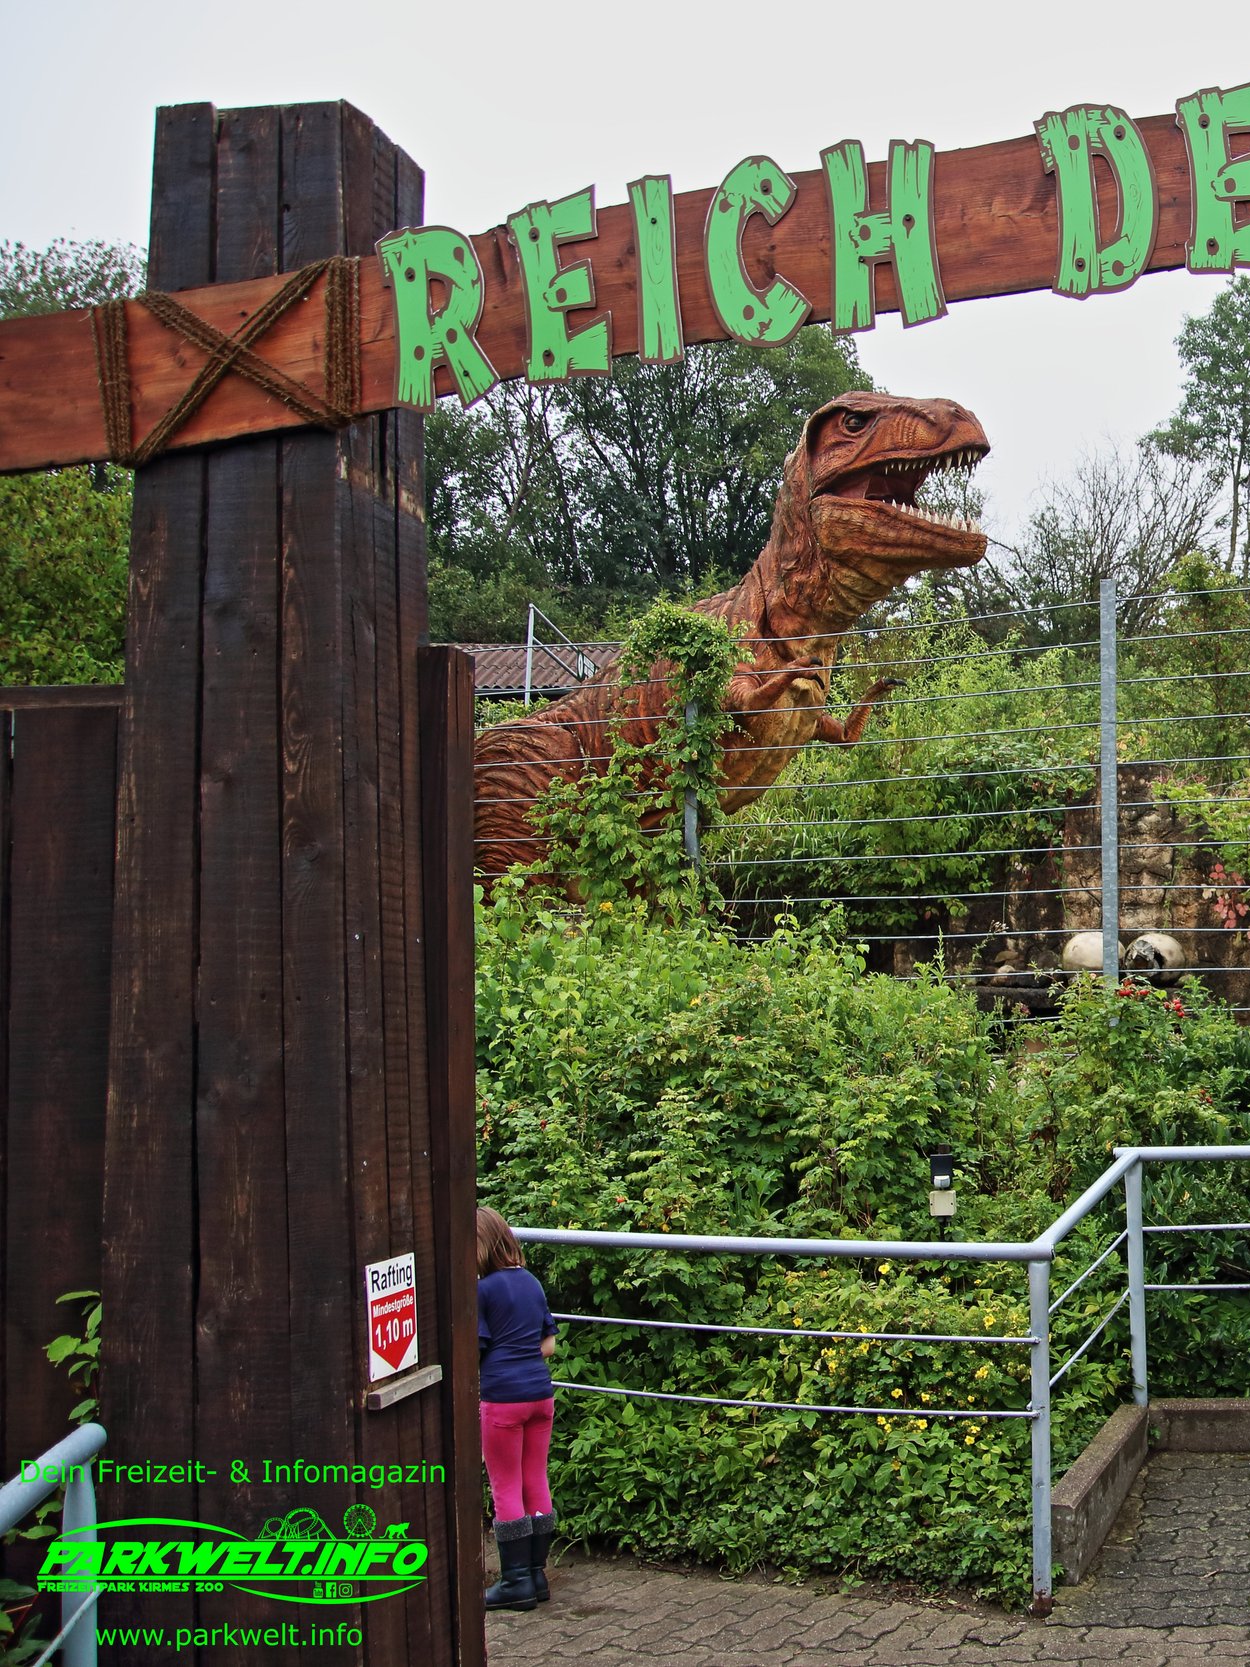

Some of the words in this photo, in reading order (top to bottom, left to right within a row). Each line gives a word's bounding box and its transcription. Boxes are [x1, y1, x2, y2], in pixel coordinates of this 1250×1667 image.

[379, 137, 946, 410] REICH
[371, 1263, 413, 1293] Rafting
[372, 1293, 414, 1319] Mindestgröße
[375, 1317, 400, 1351] 1,10
[402, 1317, 414, 1339] m
